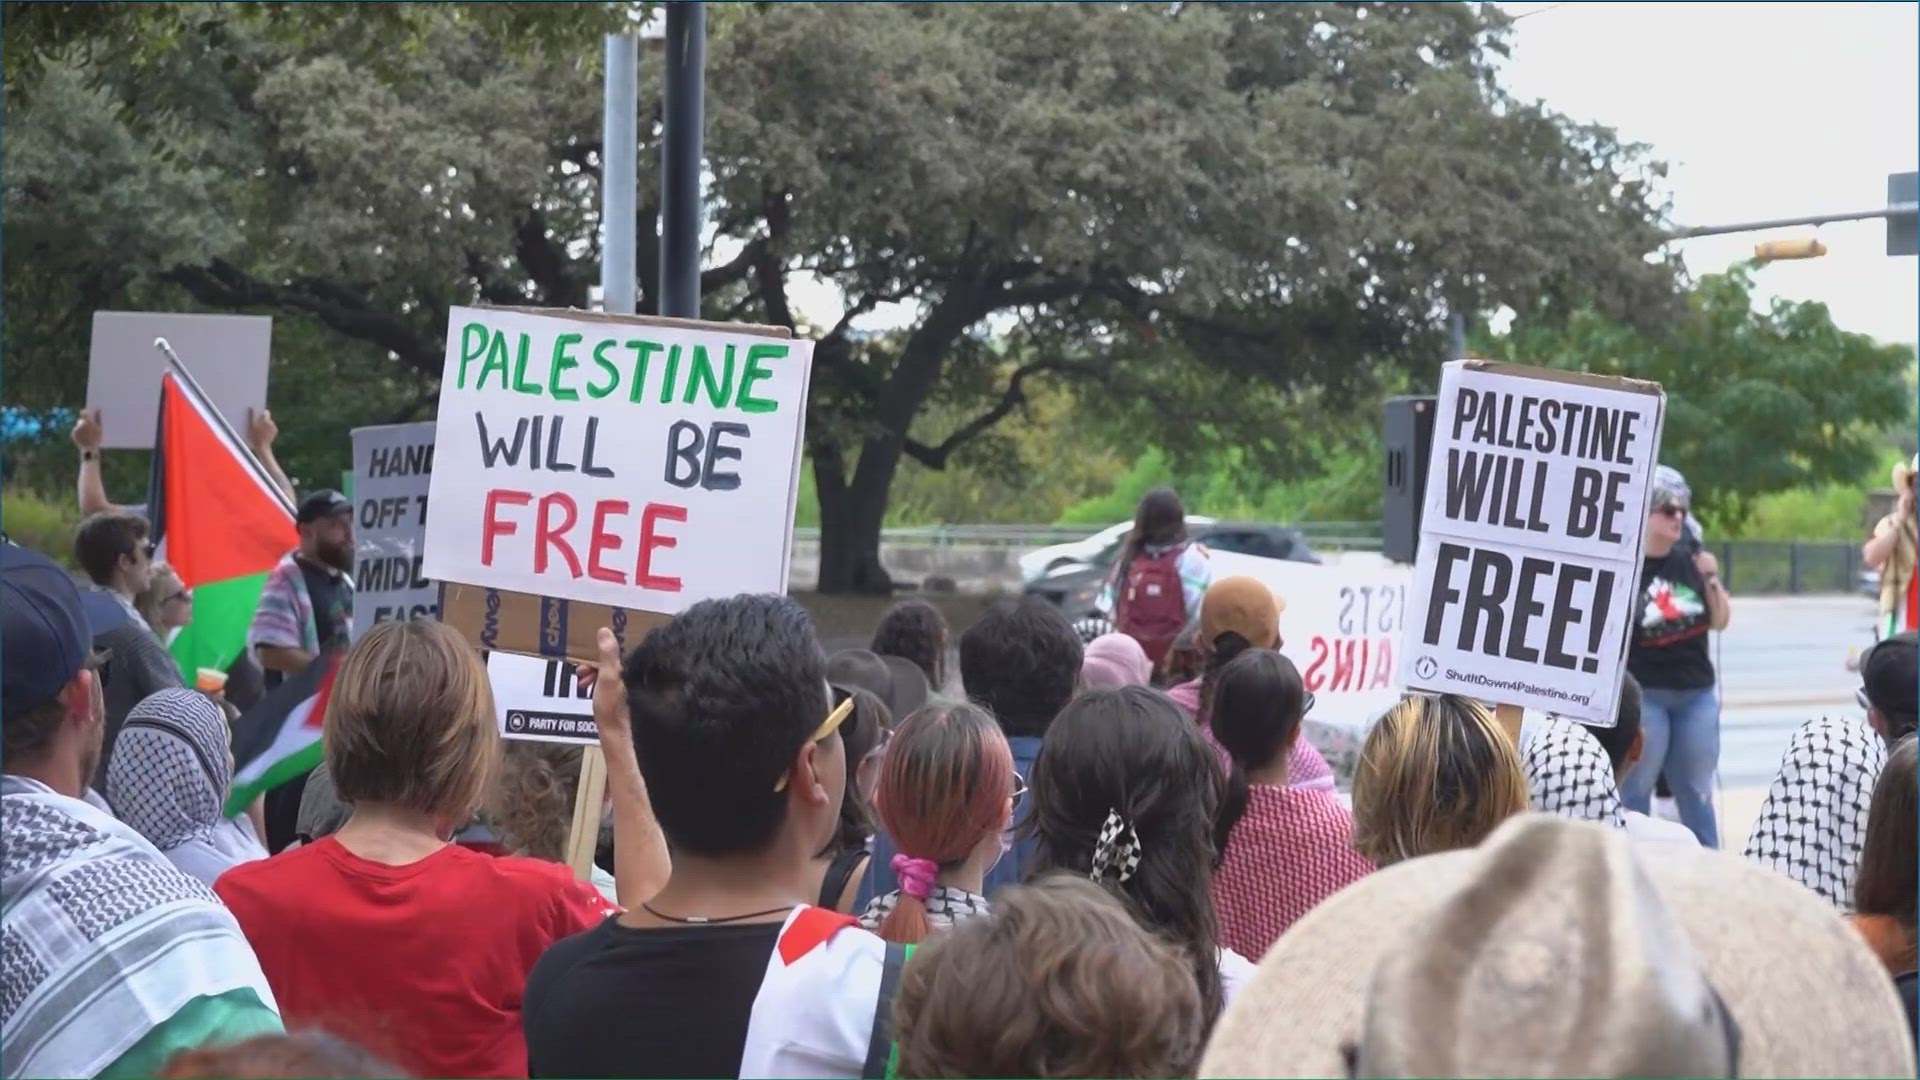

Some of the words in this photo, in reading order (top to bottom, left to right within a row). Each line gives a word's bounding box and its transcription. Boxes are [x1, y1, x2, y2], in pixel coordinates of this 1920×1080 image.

[457, 322, 790, 413] PALESTINE
[475, 411, 615, 478] WILL
[664, 418, 751, 491] BE
[1452, 387, 1640, 465] PALESTINE
[360, 496, 410, 529] OFF
[1445, 448, 1550, 533] WILL
[1566, 466, 1631, 544] BE
[481, 488, 688, 592] FREE
[1423, 542, 1616, 675] FREE!
[529, 717, 558, 731] PARTY
[558, 719, 576, 732] FOR
